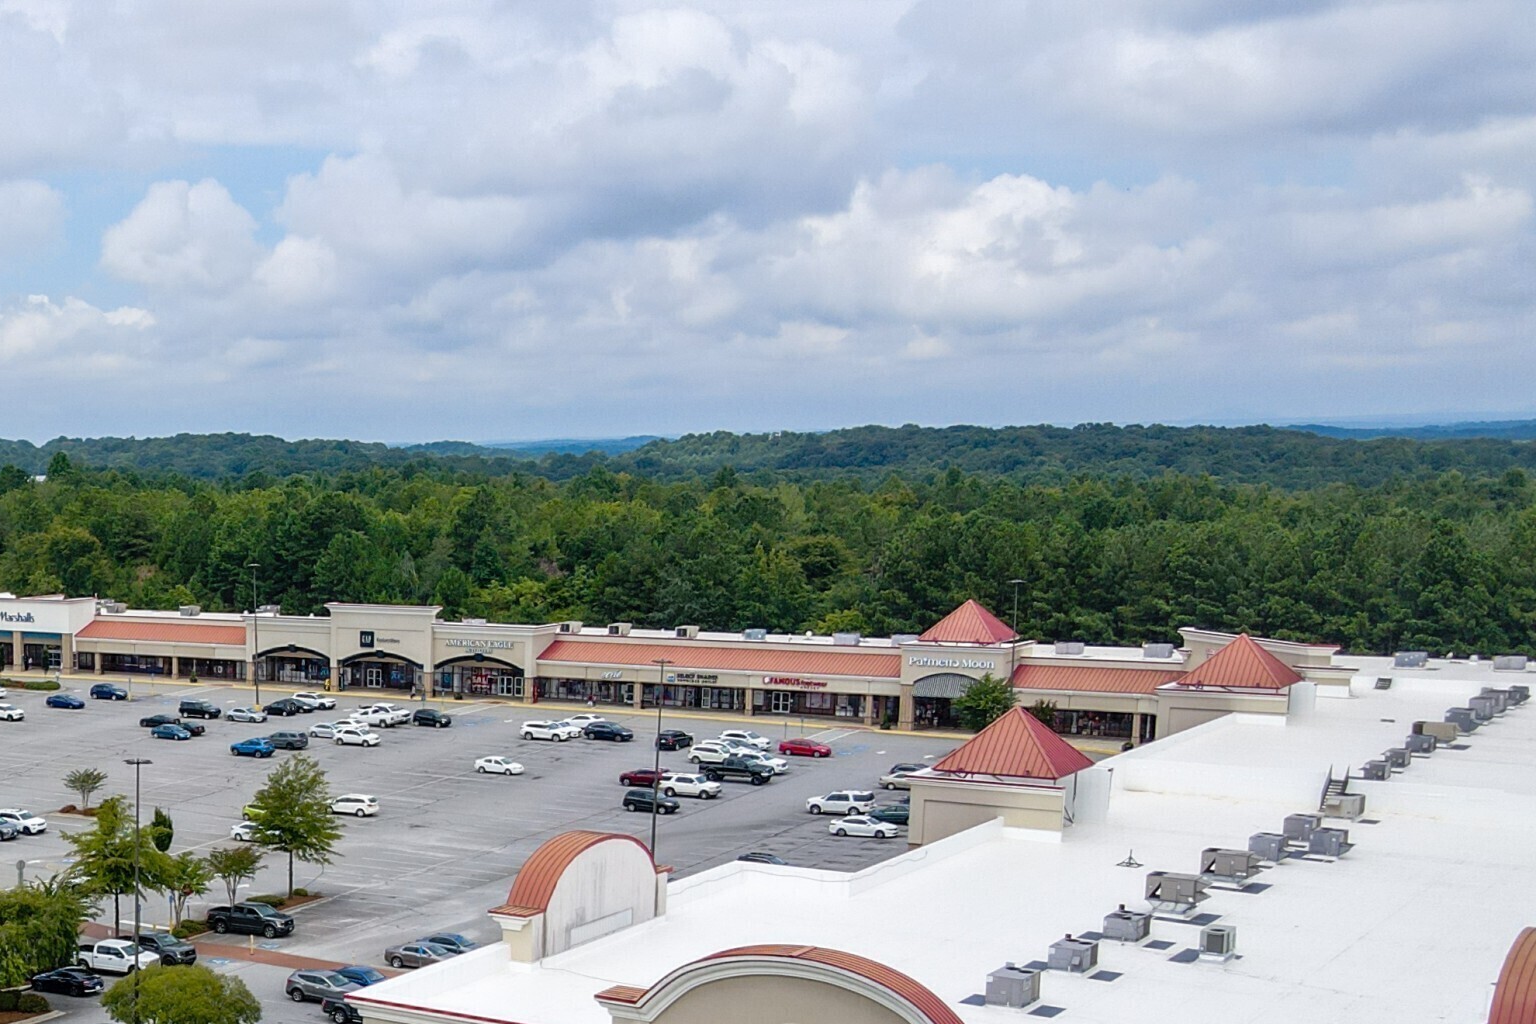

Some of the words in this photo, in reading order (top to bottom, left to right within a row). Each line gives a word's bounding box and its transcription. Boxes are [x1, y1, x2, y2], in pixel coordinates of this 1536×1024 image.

[445, 639, 486, 648] AMERICAN
[488, 640, 514, 649] EAGLE
[908, 656, 960, 668] Palmetto
[962, 659, 995, 669] Moon
[770, 677, 800, 686] FAMOUS
